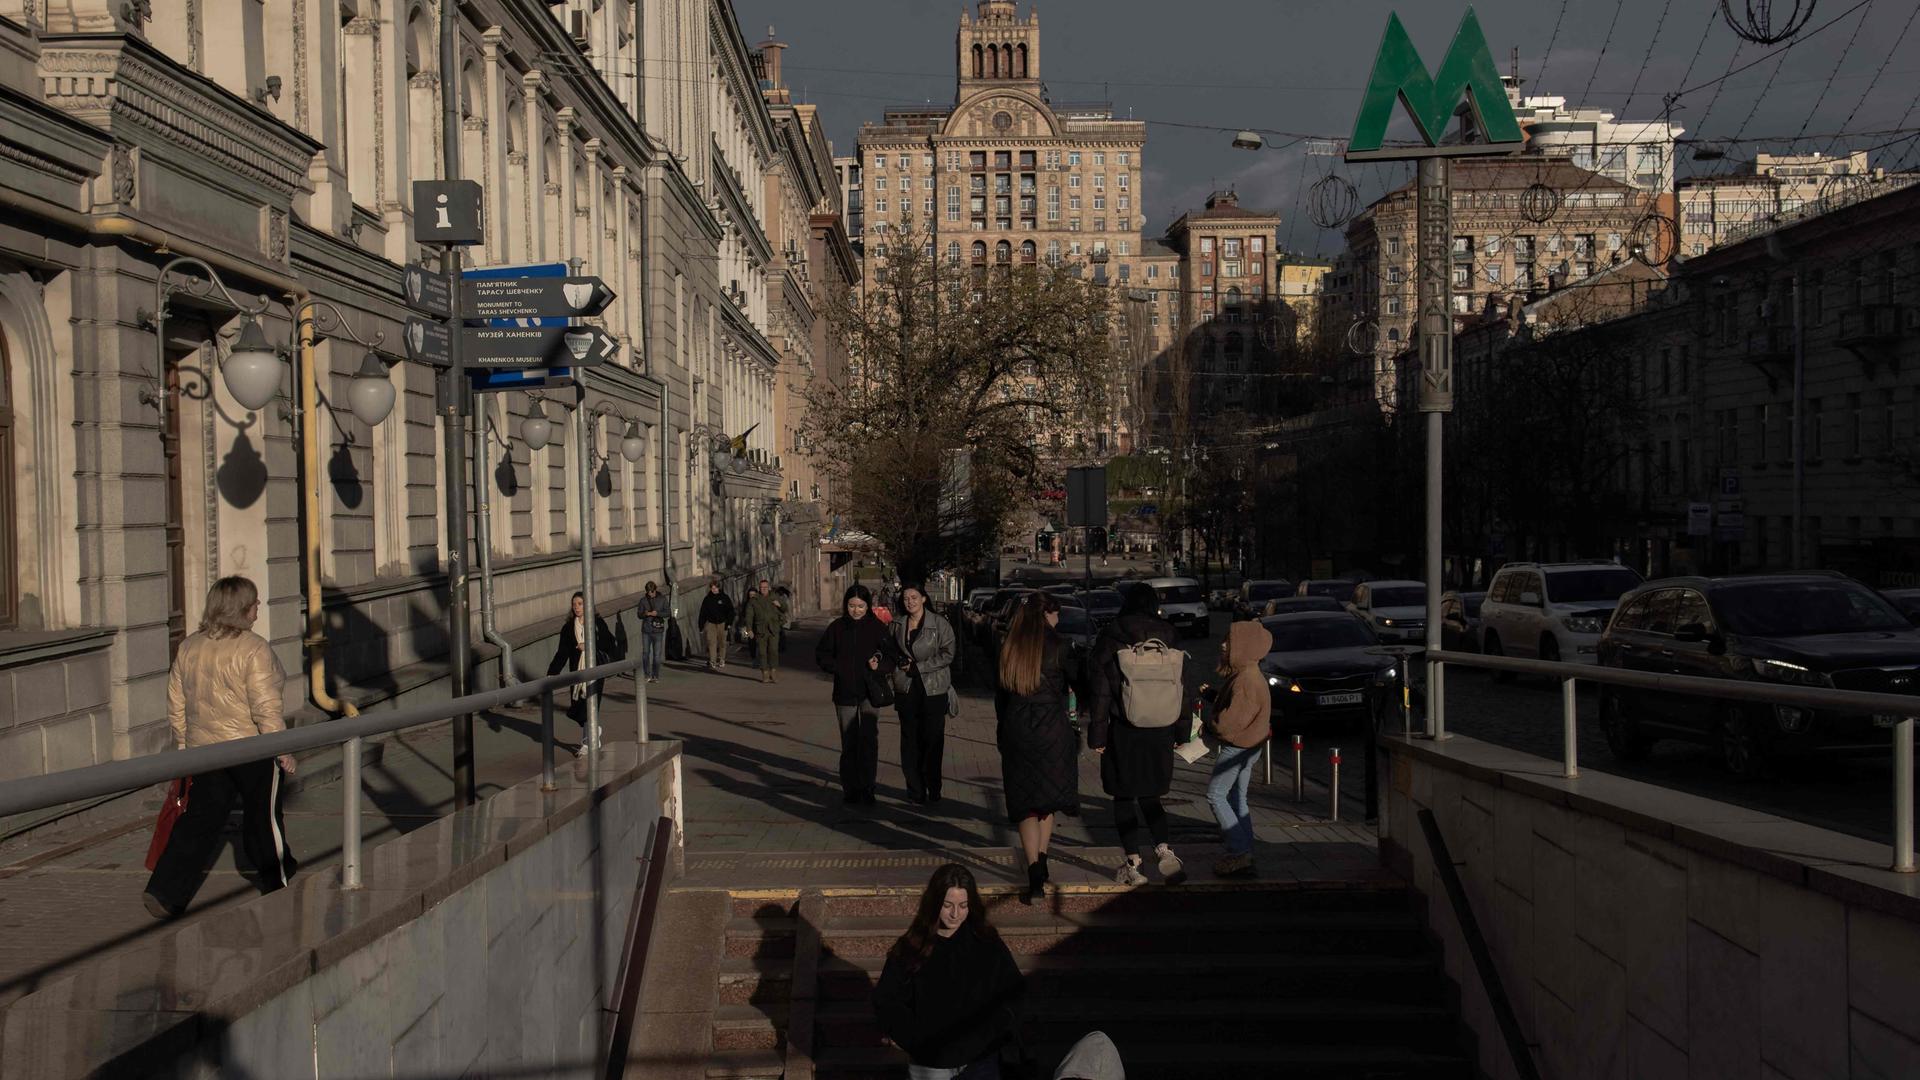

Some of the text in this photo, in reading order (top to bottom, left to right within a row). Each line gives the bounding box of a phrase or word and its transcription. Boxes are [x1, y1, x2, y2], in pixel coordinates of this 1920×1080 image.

[1348, 5, 1523, 152] М
[435, 193, 452, 229] i
[1725, 478, 1737, 493] P
